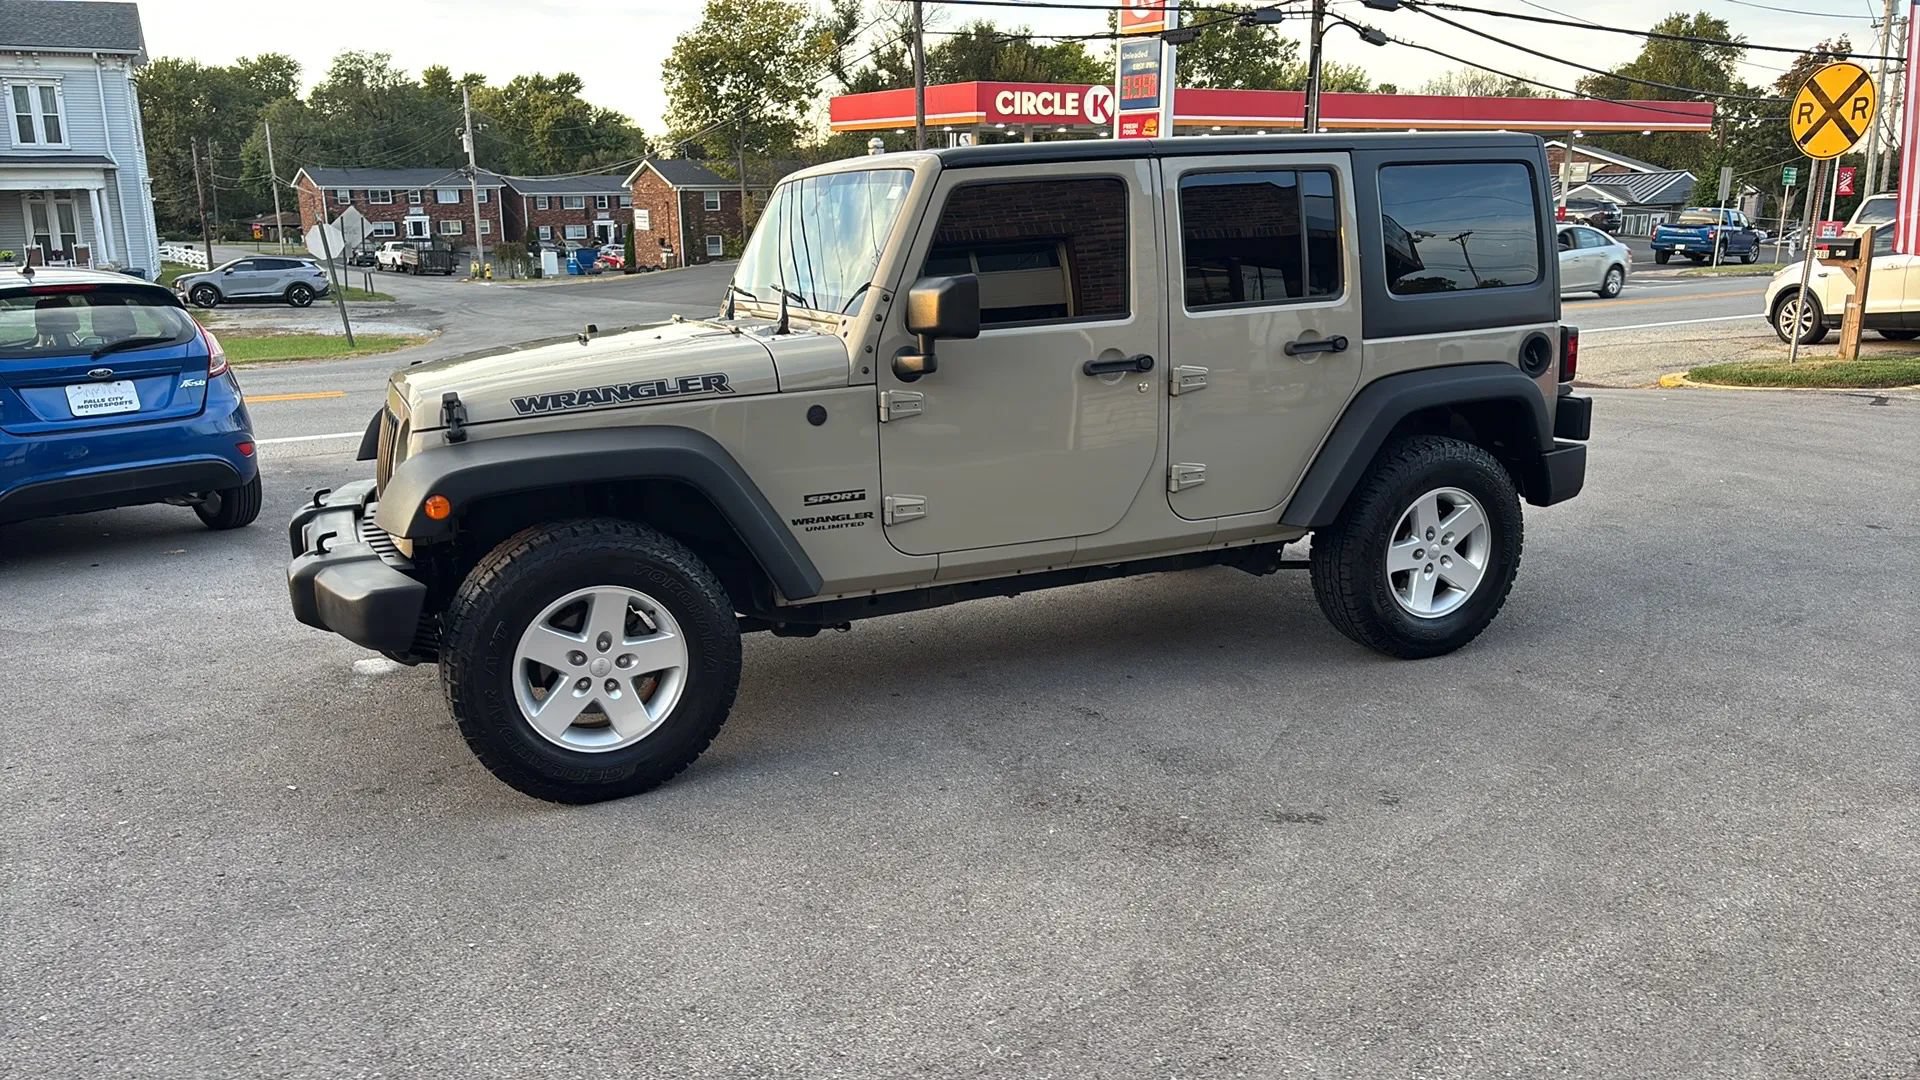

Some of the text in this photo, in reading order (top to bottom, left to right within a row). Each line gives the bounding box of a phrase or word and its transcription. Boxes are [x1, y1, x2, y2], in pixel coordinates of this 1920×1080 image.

[995, 90, 1080, 116] CIRCLE
[1796, 96, 1870, 125] R R
[511, 372, 736, 415] WRANGLER
[77, 400, 133, 409] MOTORSPORTS
[807, 492, 861, 503] SPORT
[791, 512, 875, 526] WRANGLER
[805, 521, 865, 532] UNLIMITED
